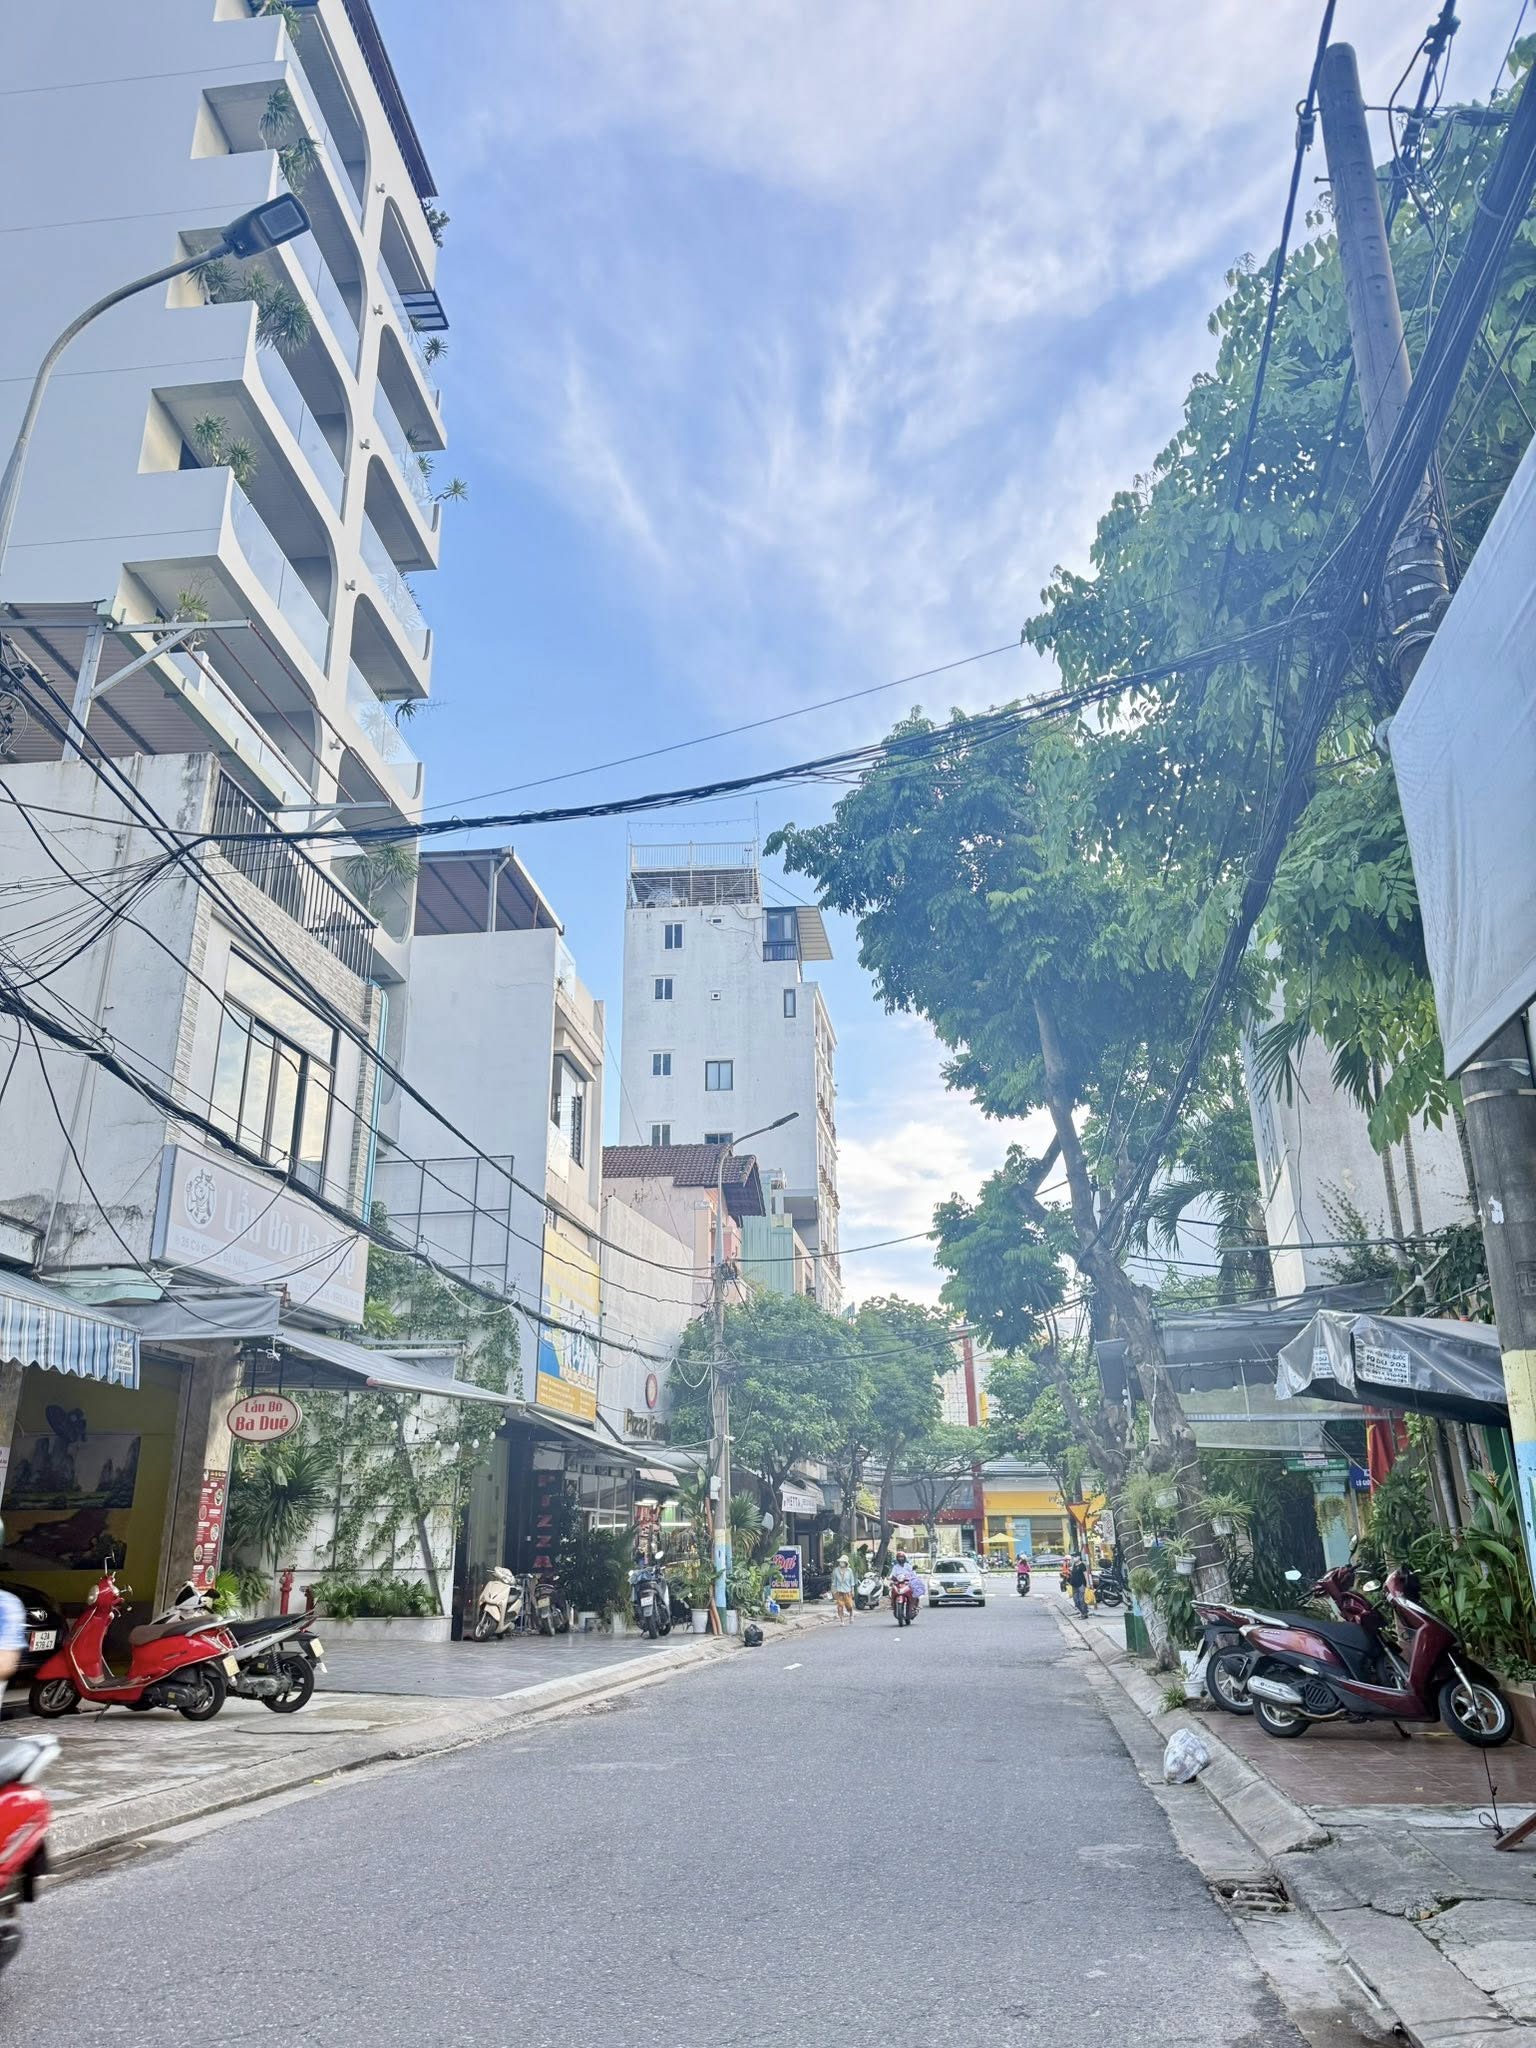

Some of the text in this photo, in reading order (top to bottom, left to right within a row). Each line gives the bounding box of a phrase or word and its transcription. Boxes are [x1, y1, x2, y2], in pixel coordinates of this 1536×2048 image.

[267, 1208, 291, 1255] Bò
[244, 1400, 283, 1413] Lẩu Bò
[235, 1414, 289, 1432] Ba Duệ
